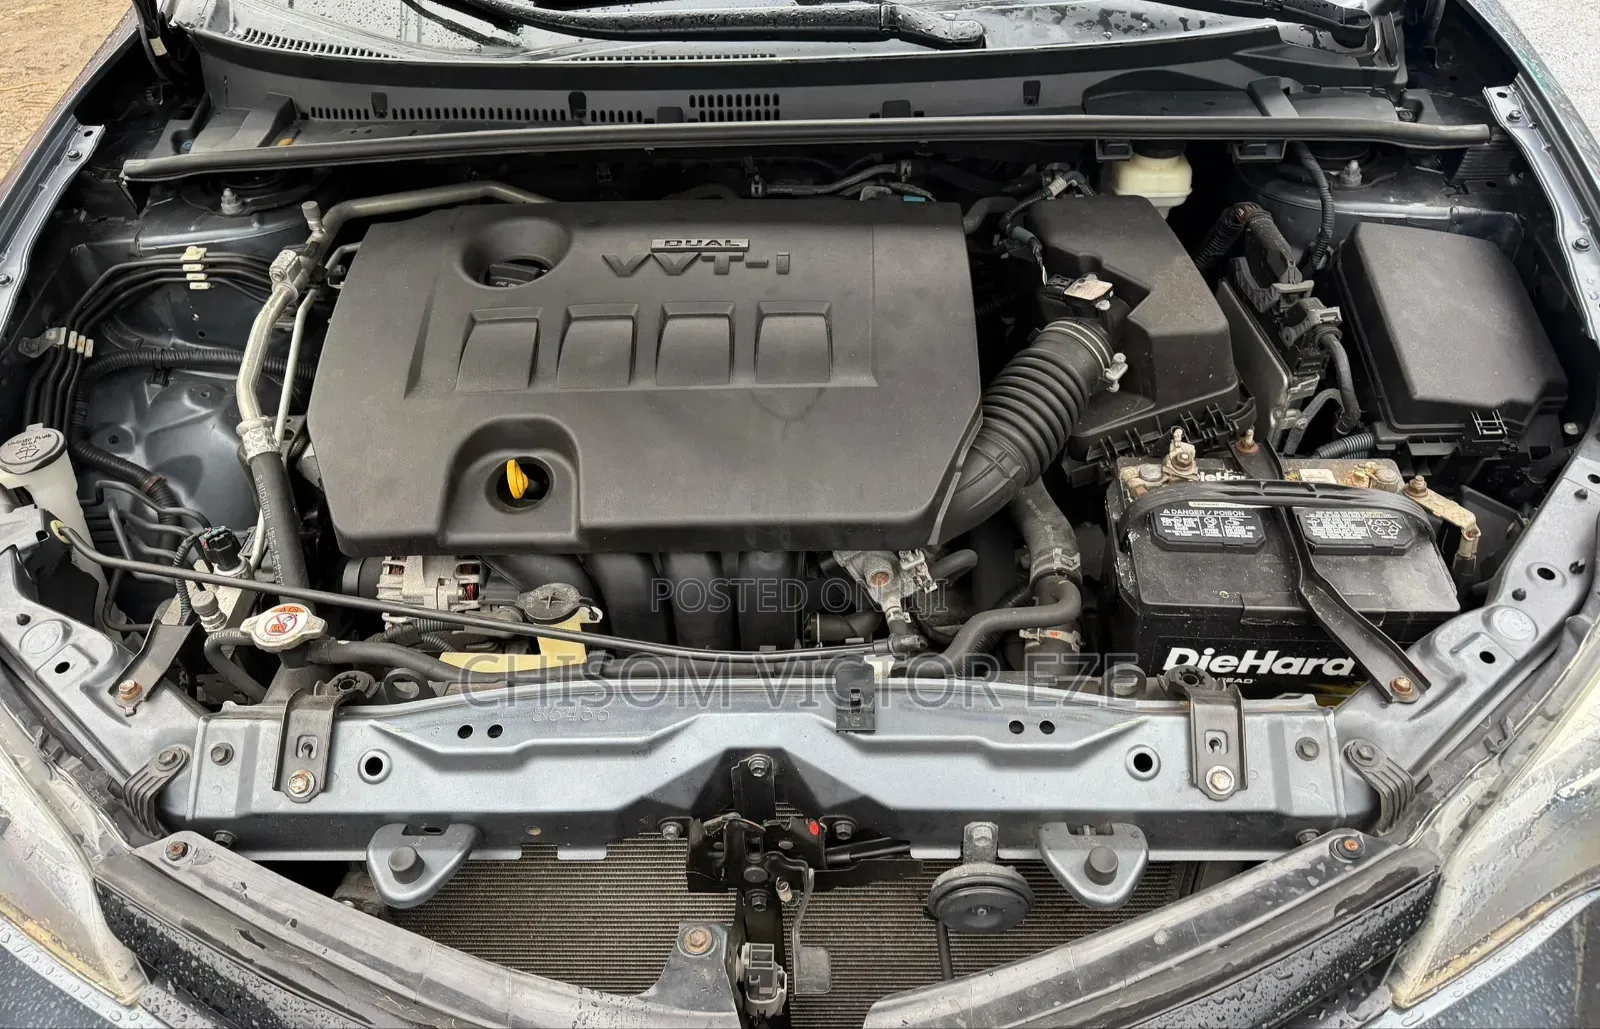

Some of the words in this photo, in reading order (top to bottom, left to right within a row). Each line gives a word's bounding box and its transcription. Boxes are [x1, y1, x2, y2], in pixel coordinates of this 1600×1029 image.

[664, 240, 740, 248] DUAL
[602, 251, 790, 277] VVT-i
[1199, 471, 1247, 481] ieHar
[1170, 508, 1206, 516] DANGER
[1162, 647, 1356, 676] DieHard
